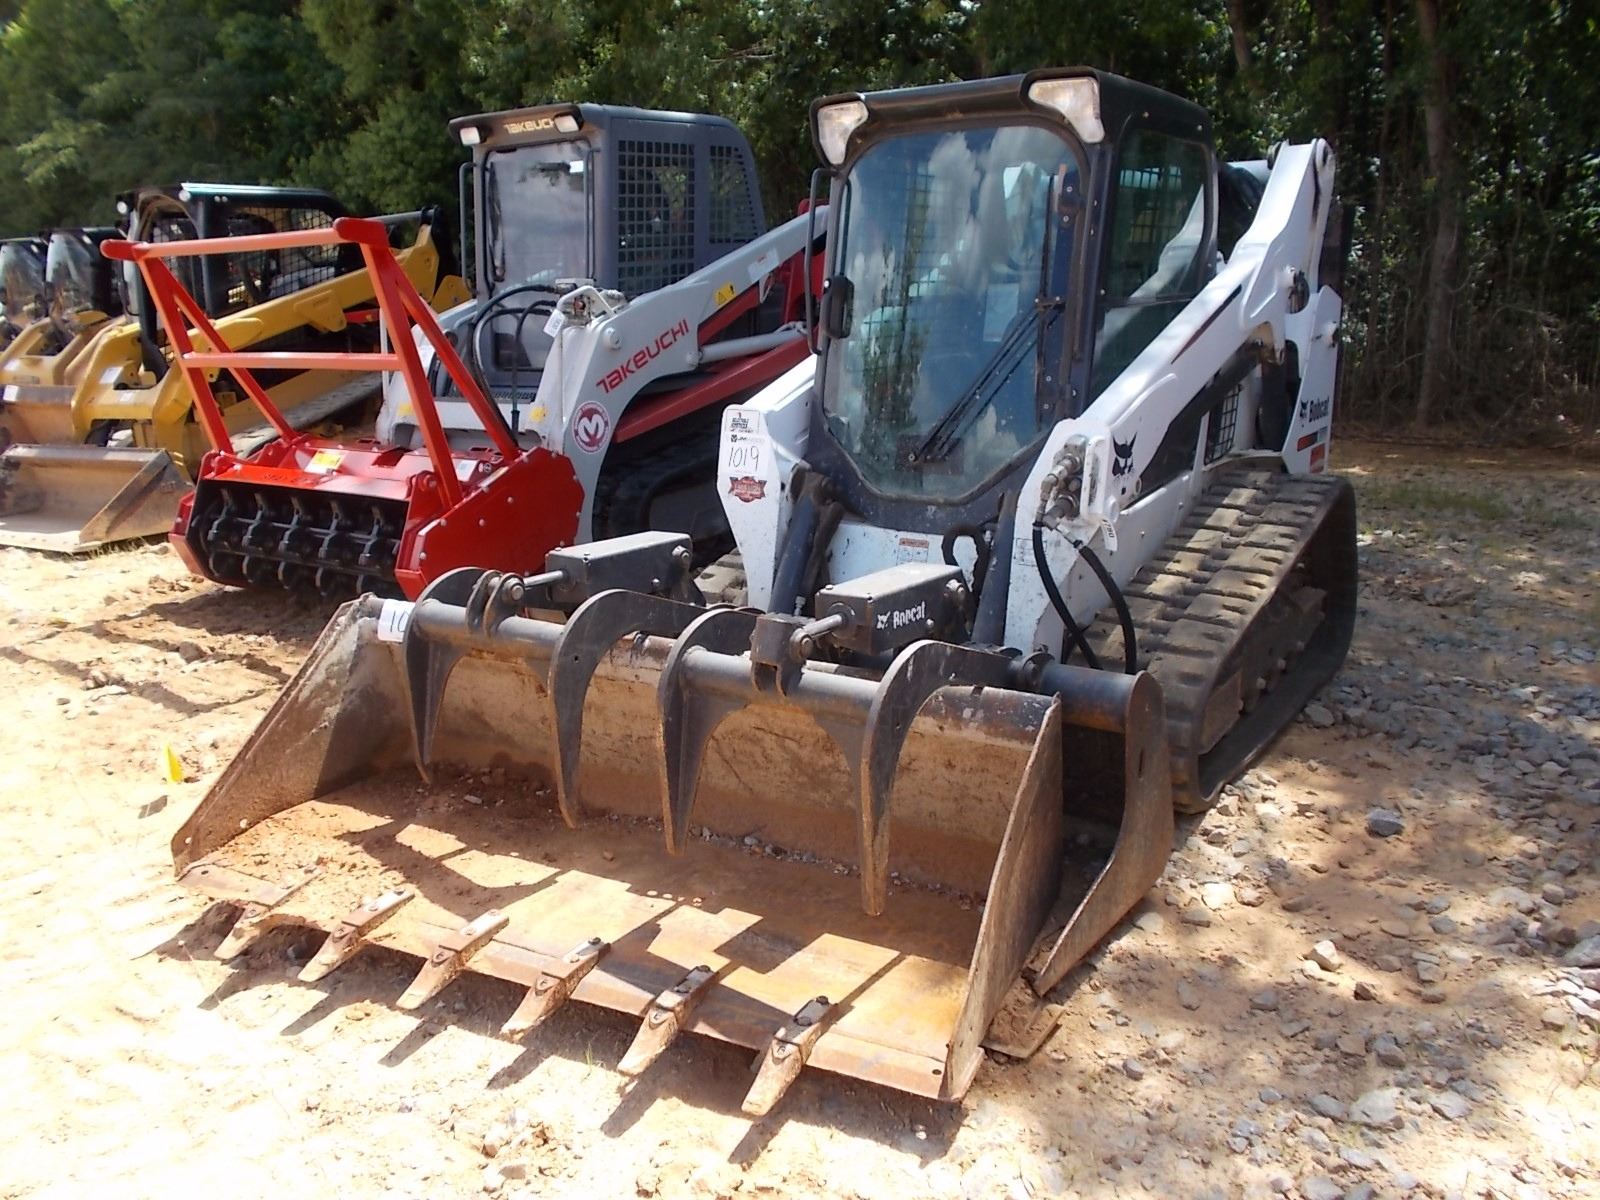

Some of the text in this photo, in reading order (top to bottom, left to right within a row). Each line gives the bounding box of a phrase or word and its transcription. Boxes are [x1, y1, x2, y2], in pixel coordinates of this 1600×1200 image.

[596, 319, 690, 394] TAKEUCHI
[728, 446, 760, 472] 1019
[390, 609, 410, 633] 10
[893, 600, 926, 630] Bobcat
